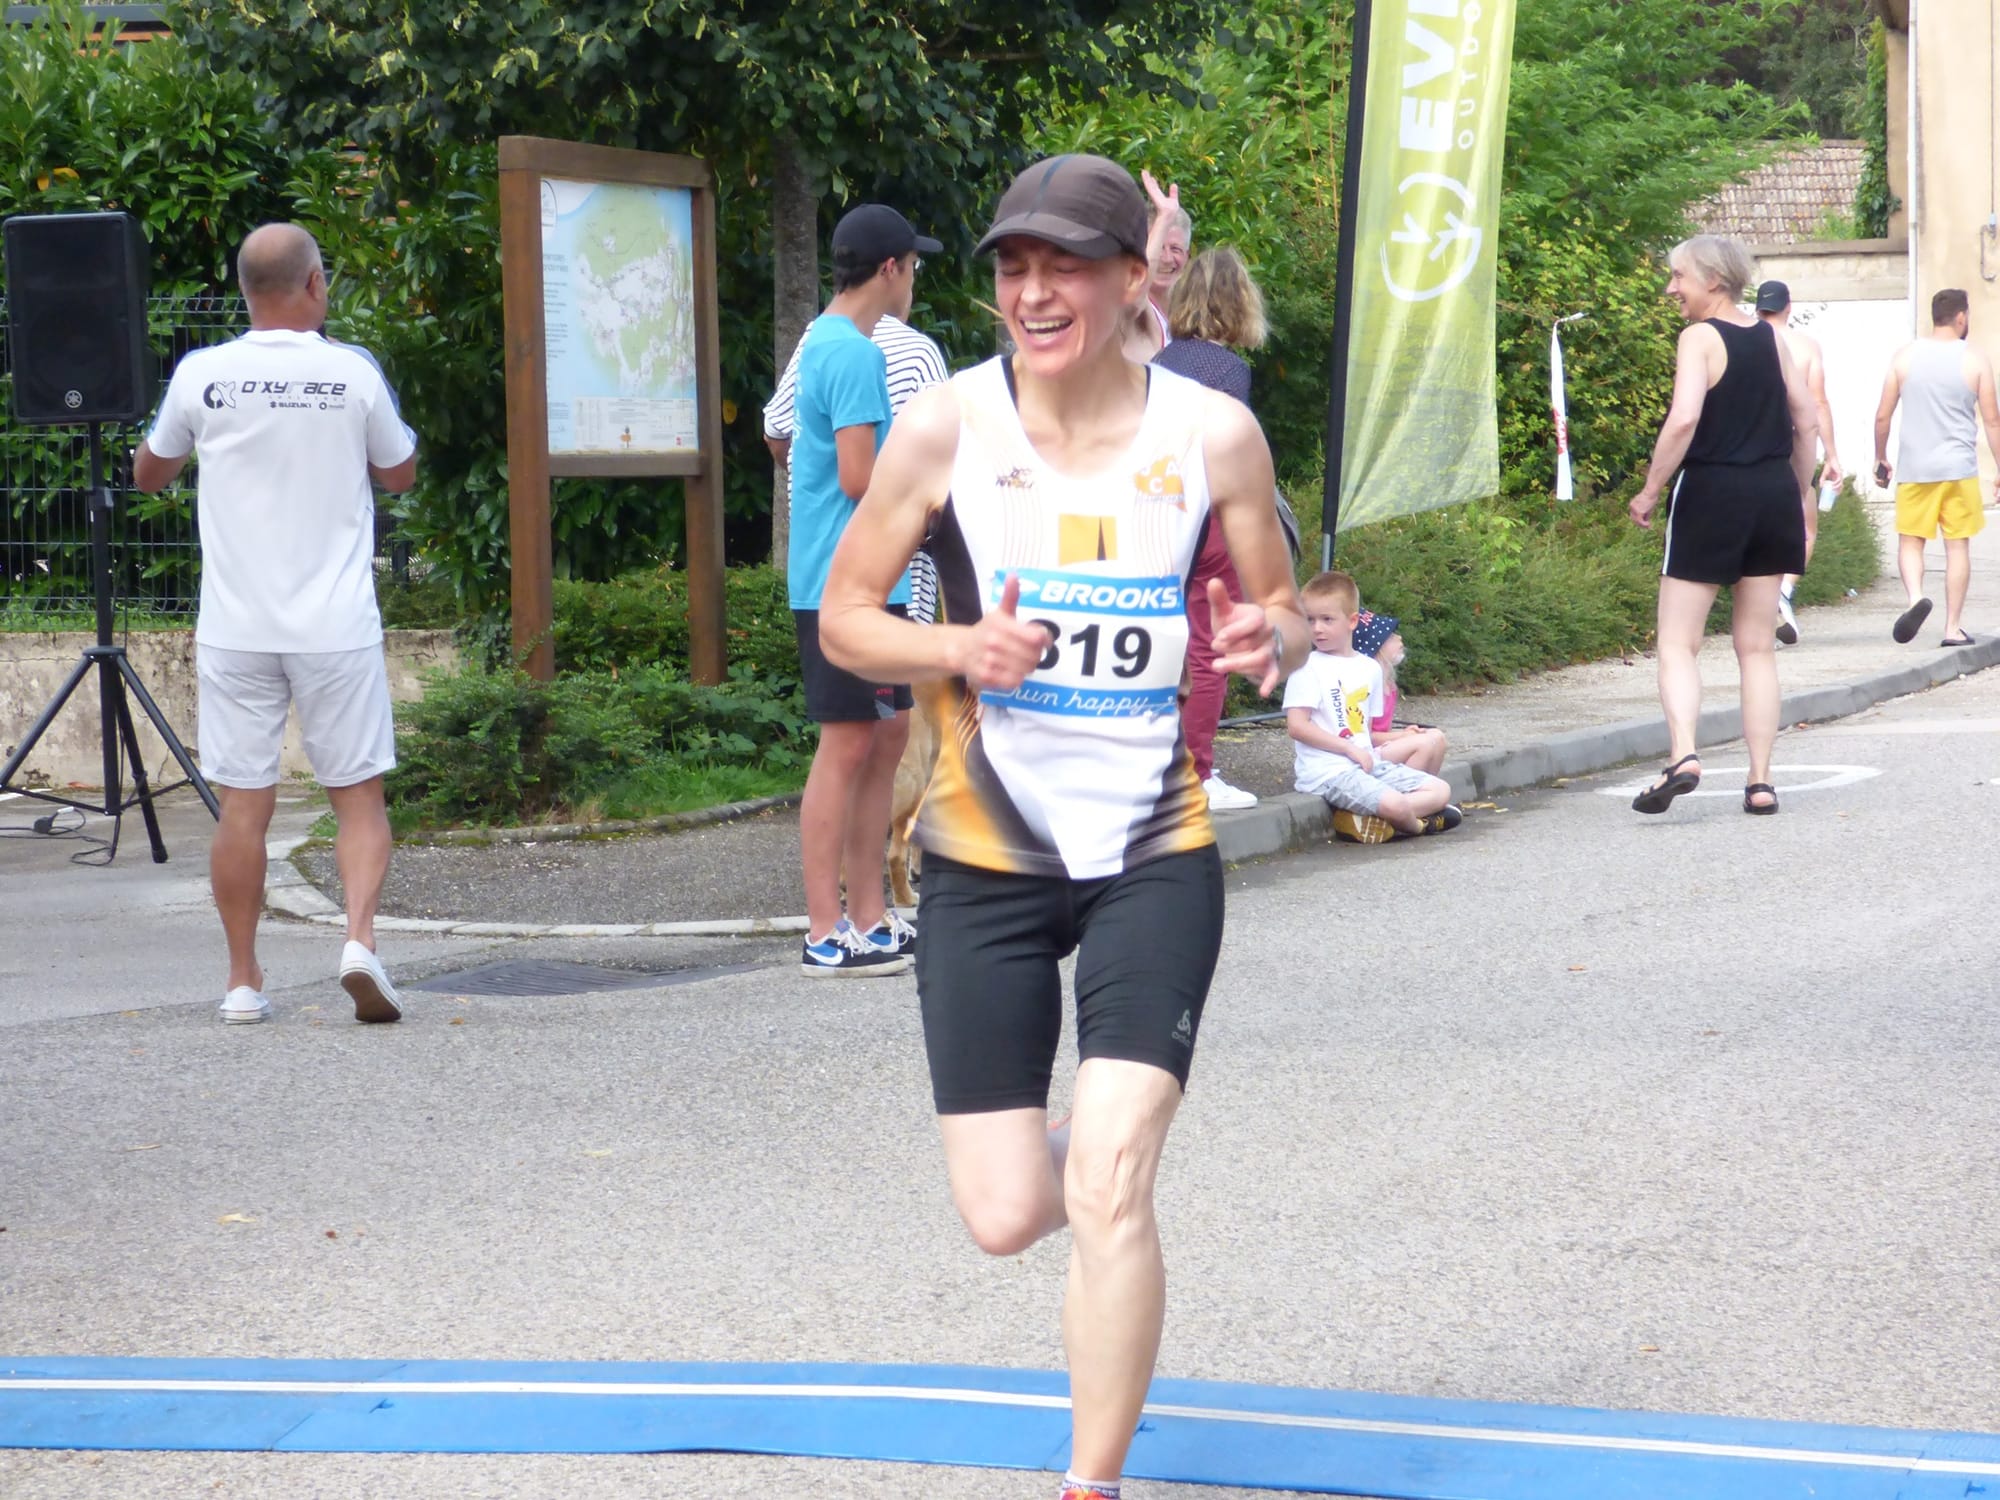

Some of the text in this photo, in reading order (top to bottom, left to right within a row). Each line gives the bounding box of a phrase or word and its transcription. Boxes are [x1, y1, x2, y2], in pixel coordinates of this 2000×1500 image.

[1040, 580, 1178, 610] BROOKS
[1065, 690, 1152, 716] happy
[1330, 687, 1347, 728] PIKACHU
